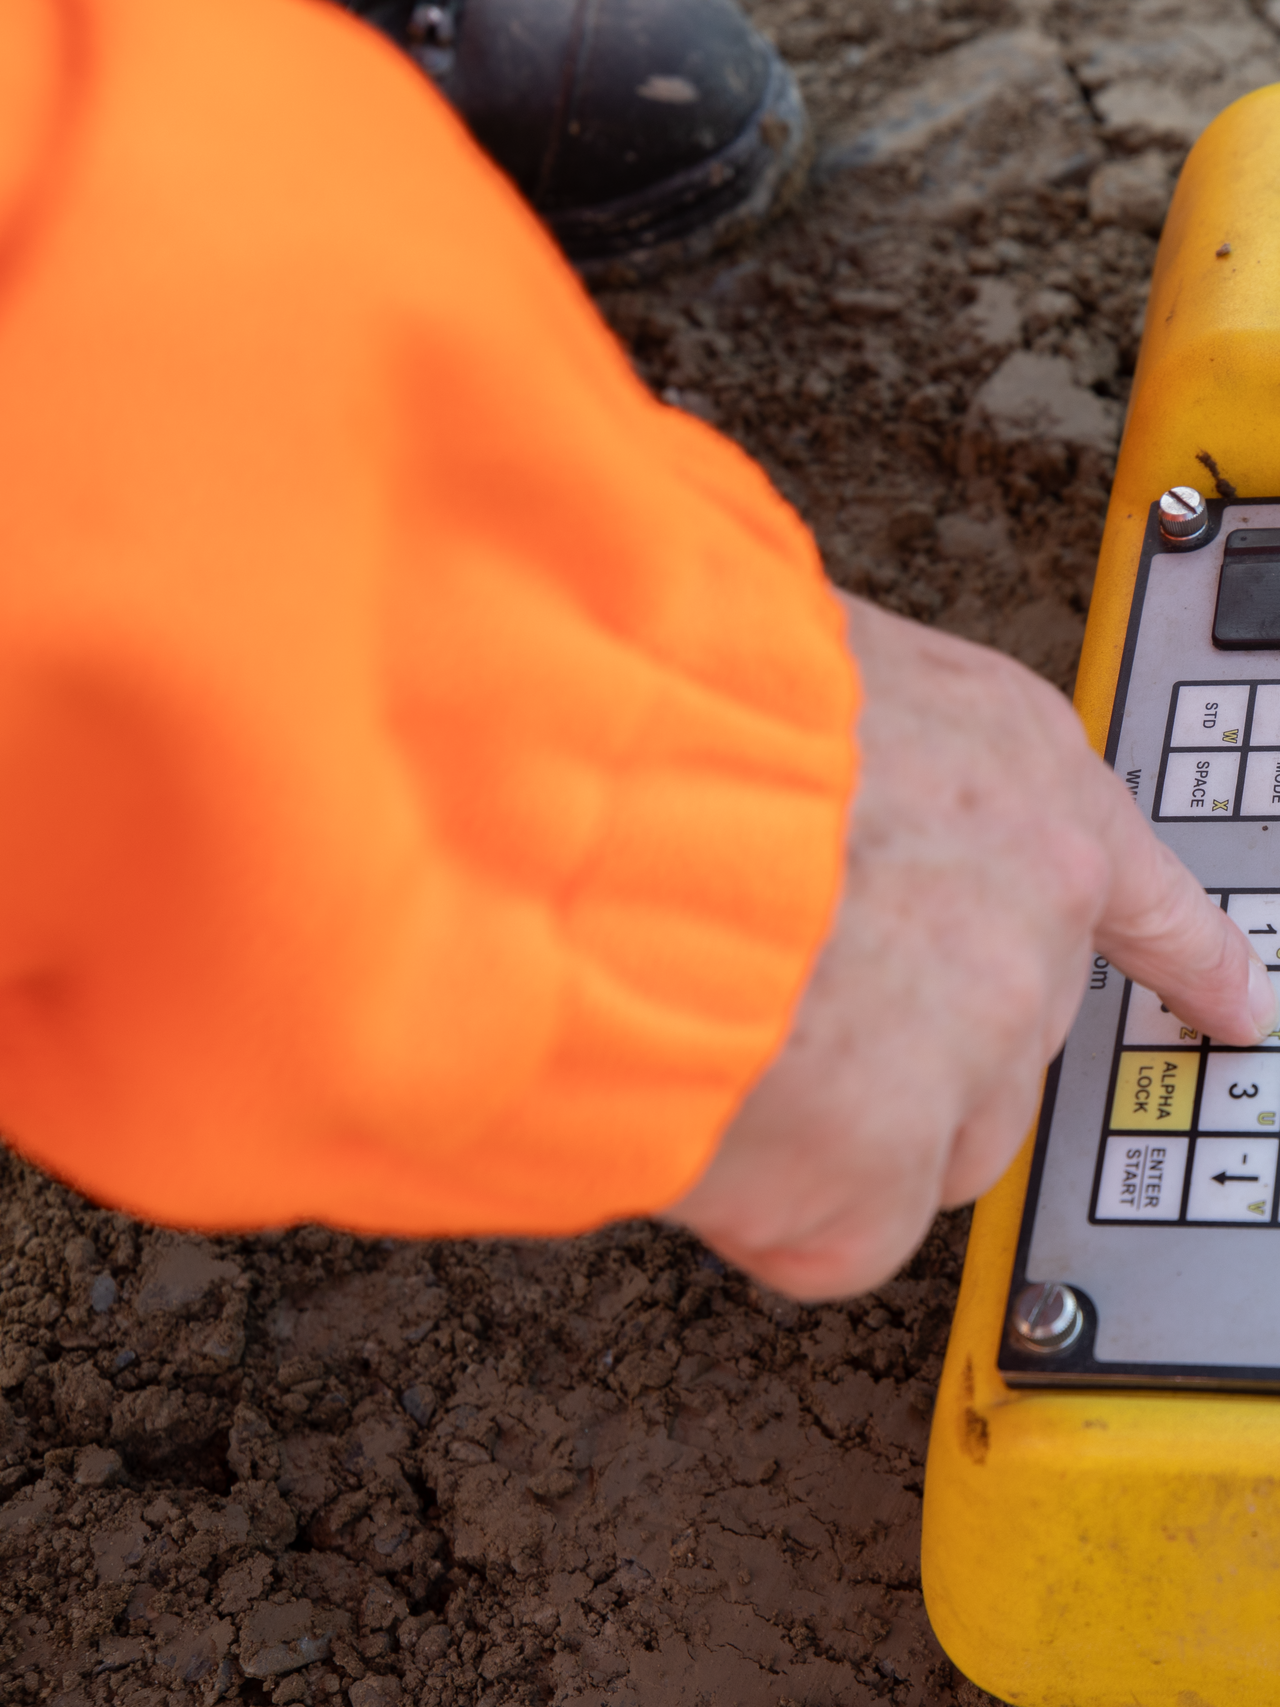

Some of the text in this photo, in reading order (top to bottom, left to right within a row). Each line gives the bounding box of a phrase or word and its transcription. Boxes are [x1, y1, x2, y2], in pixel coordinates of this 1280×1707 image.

[1204, 702, 1219, 729] STD
[1222, 729, 1240, 743] W
[1190, 760, 1211, 808] SPACE
[1211, 799, 1229, 811] X
[1249, 923, 1277, 935] 1
[1180, 1027, 1198, 1039] Z
[1133, 1065, 1154, 1113] LOCK
[1157, 1061, 1178, 1120] ALPHA
[1228, 1083, 1259, 1099] 3
[1257, 1112, 1276, 1125] U
[1119, 1149, 1141, 1207] START
[1143, 1148, 1166, 1208] ENTER
[1248, 1201, 1265, 1215] V
